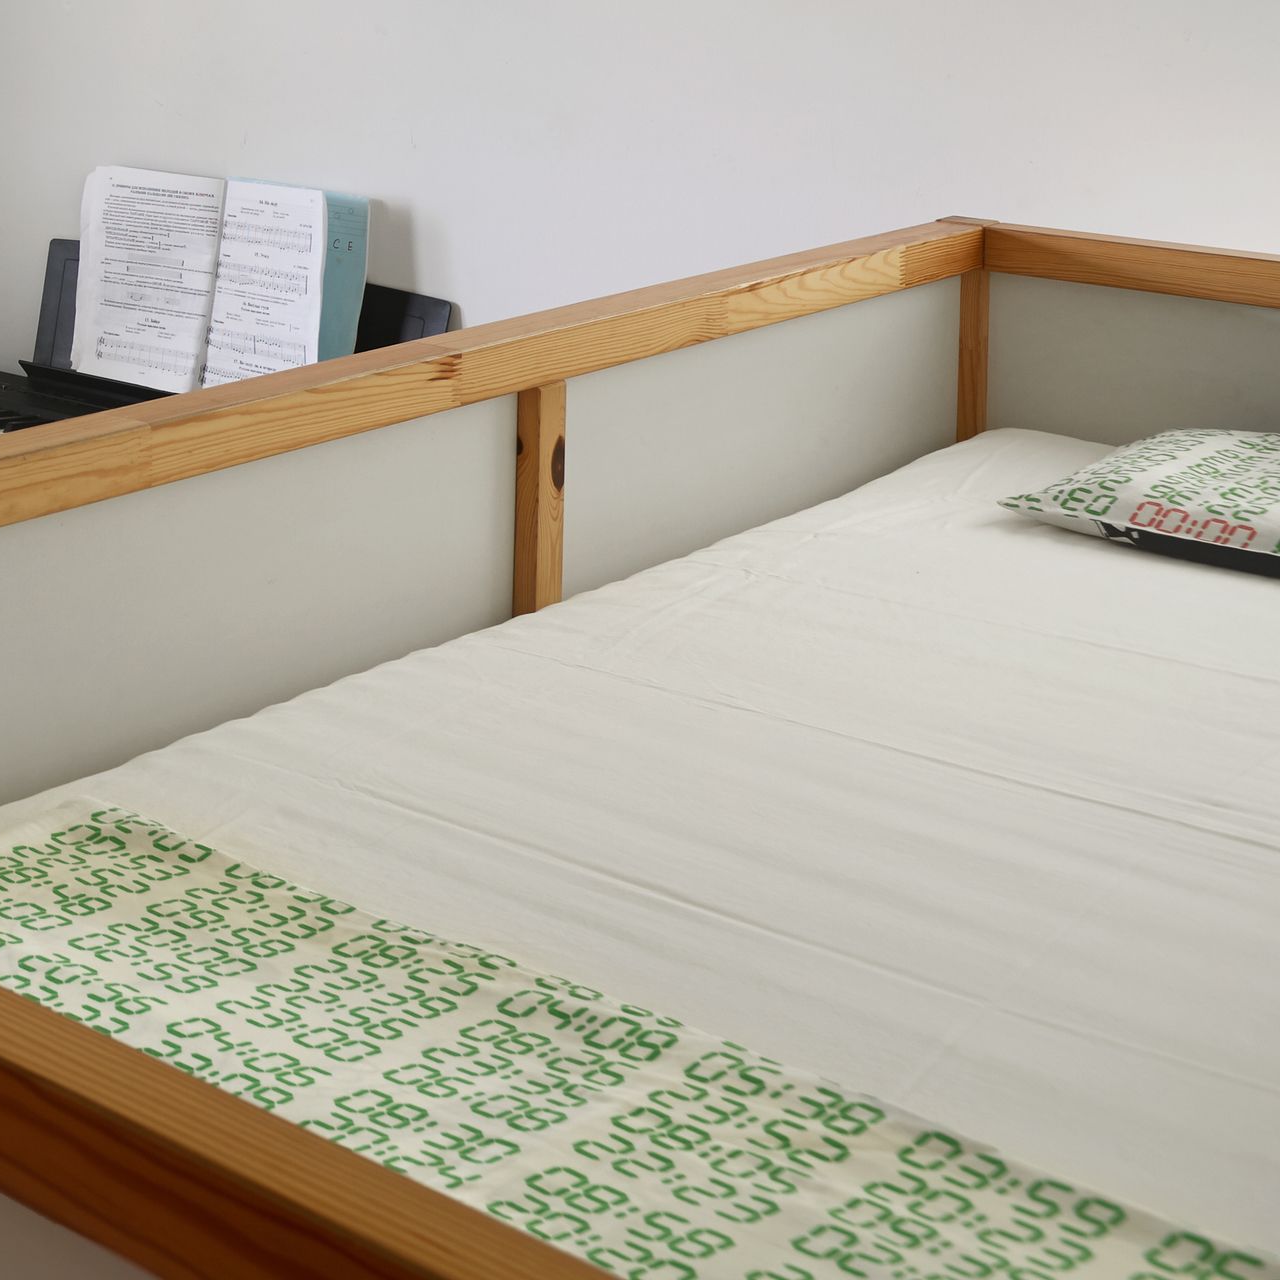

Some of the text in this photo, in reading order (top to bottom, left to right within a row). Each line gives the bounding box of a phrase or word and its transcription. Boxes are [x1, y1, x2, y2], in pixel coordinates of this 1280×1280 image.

[12, 845, 149, 896] 22:52
[51, 824, 191, 880] 00:53
[147, 901, 294, 958] 09:58
[186, 882, 333, 938] 22:33
[67, 933, 219, 994] 02:59
[107, 917, 256, 976] 20:00
[332, 935, 494, 996] 08:25
[16, 955, 167, 1015] 20:56
[256, 979, 416, 1040] 22:56
[295, 960, 458, 1018] 23:39
[163, 1017, 332, 1087] 04:06
[215, 996, 382, 1062] 23:00
[460, 1020, 632, 1088] 08:26
[497, 981, 678, 1062] 04:08
[384, 1064, 567, 1132] 06:08
[421, 1043, 596, 1108] 23:35
[684, 1053, 884, 1135] 05:38
[302, 1112, 480, 1188] 20:24
[335, 1089, 520, 1164] 08:30
[611, 1107, 811, 1194] 08:05
[649, 1085, 848, 1168] 23:52
[574, 1134, 779, 1223] 22:23
[898, 1132, 1125, 1239] 03:59
[525, 1167, 735, 1258] 08:58
[864, 1171, 1092, 1270] 20:23
[792, 1225, 954, 1280] 02:
